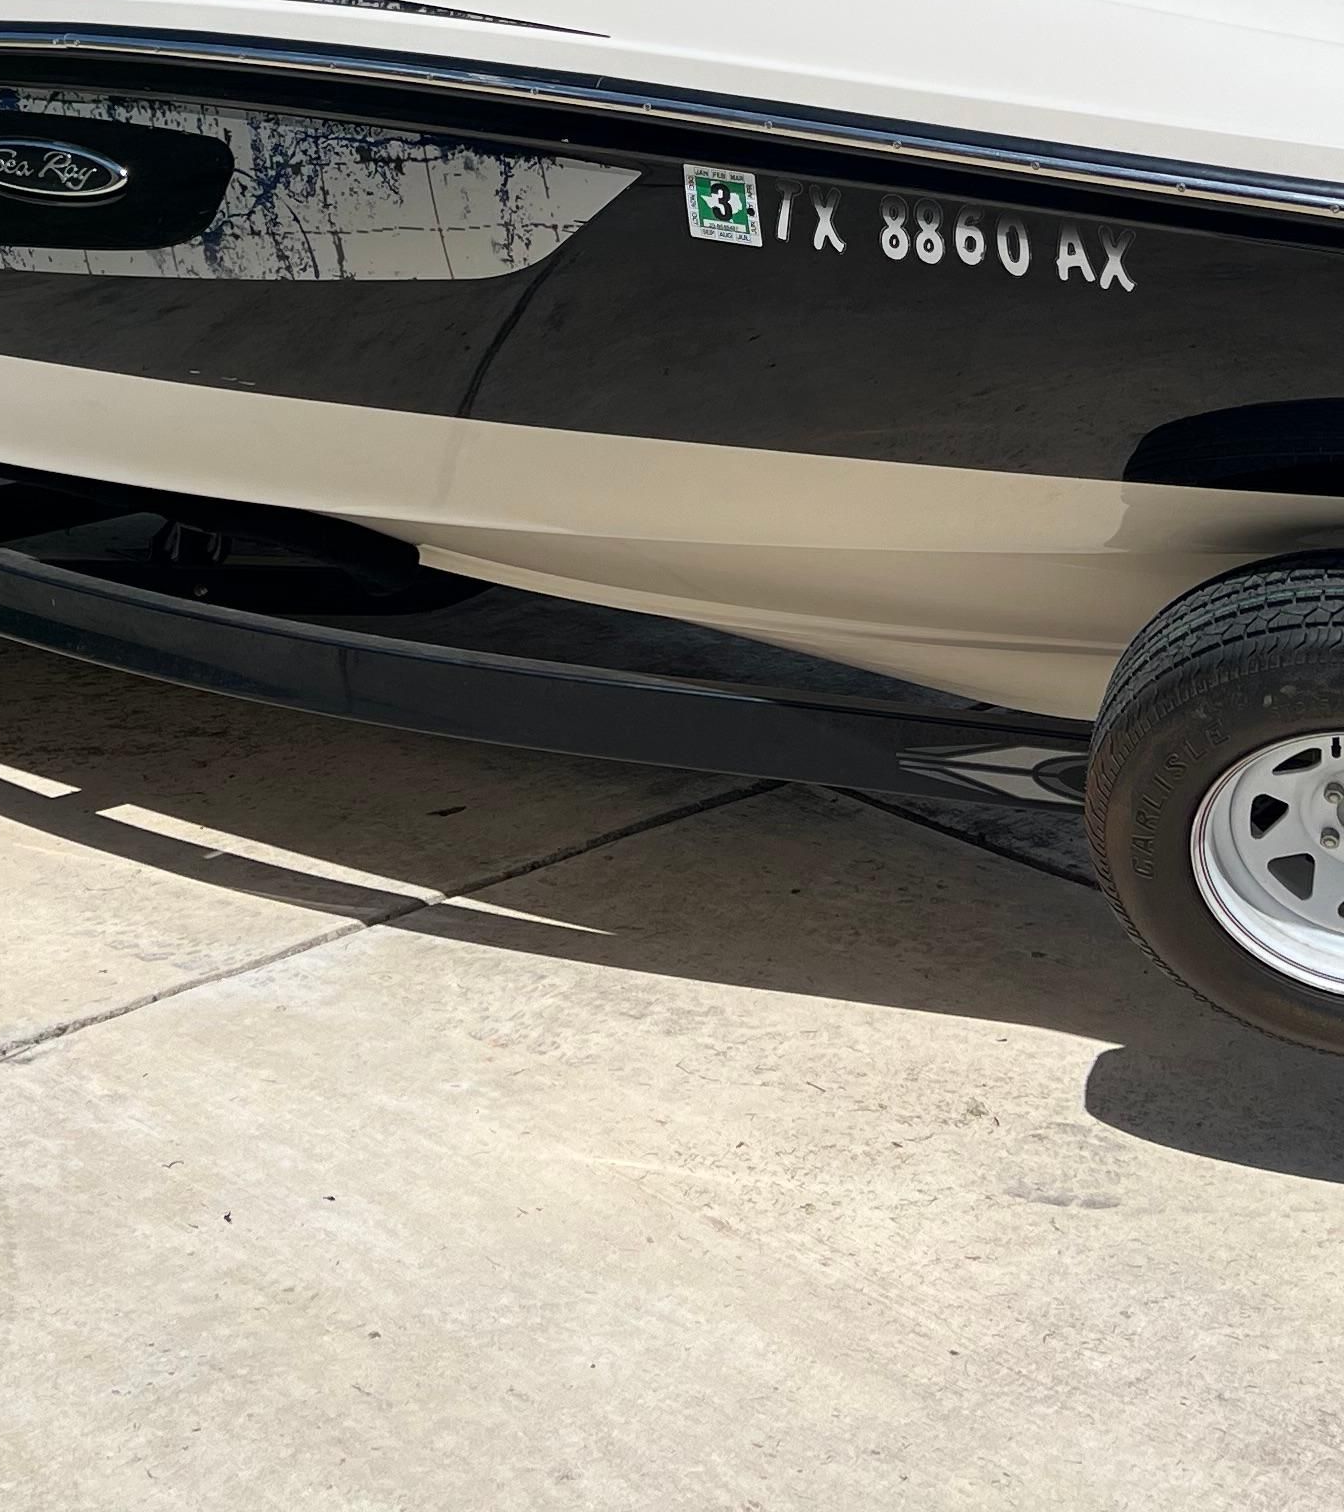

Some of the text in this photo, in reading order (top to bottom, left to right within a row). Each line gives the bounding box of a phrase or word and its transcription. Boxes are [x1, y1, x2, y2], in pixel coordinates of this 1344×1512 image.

[39, 151, 97, 190] Ray
[711, 183, 733, 222] 3
[775, 180, 1136, 292] TX 8860 AX
[1131, 720, 1231, 880] CARLISLE
